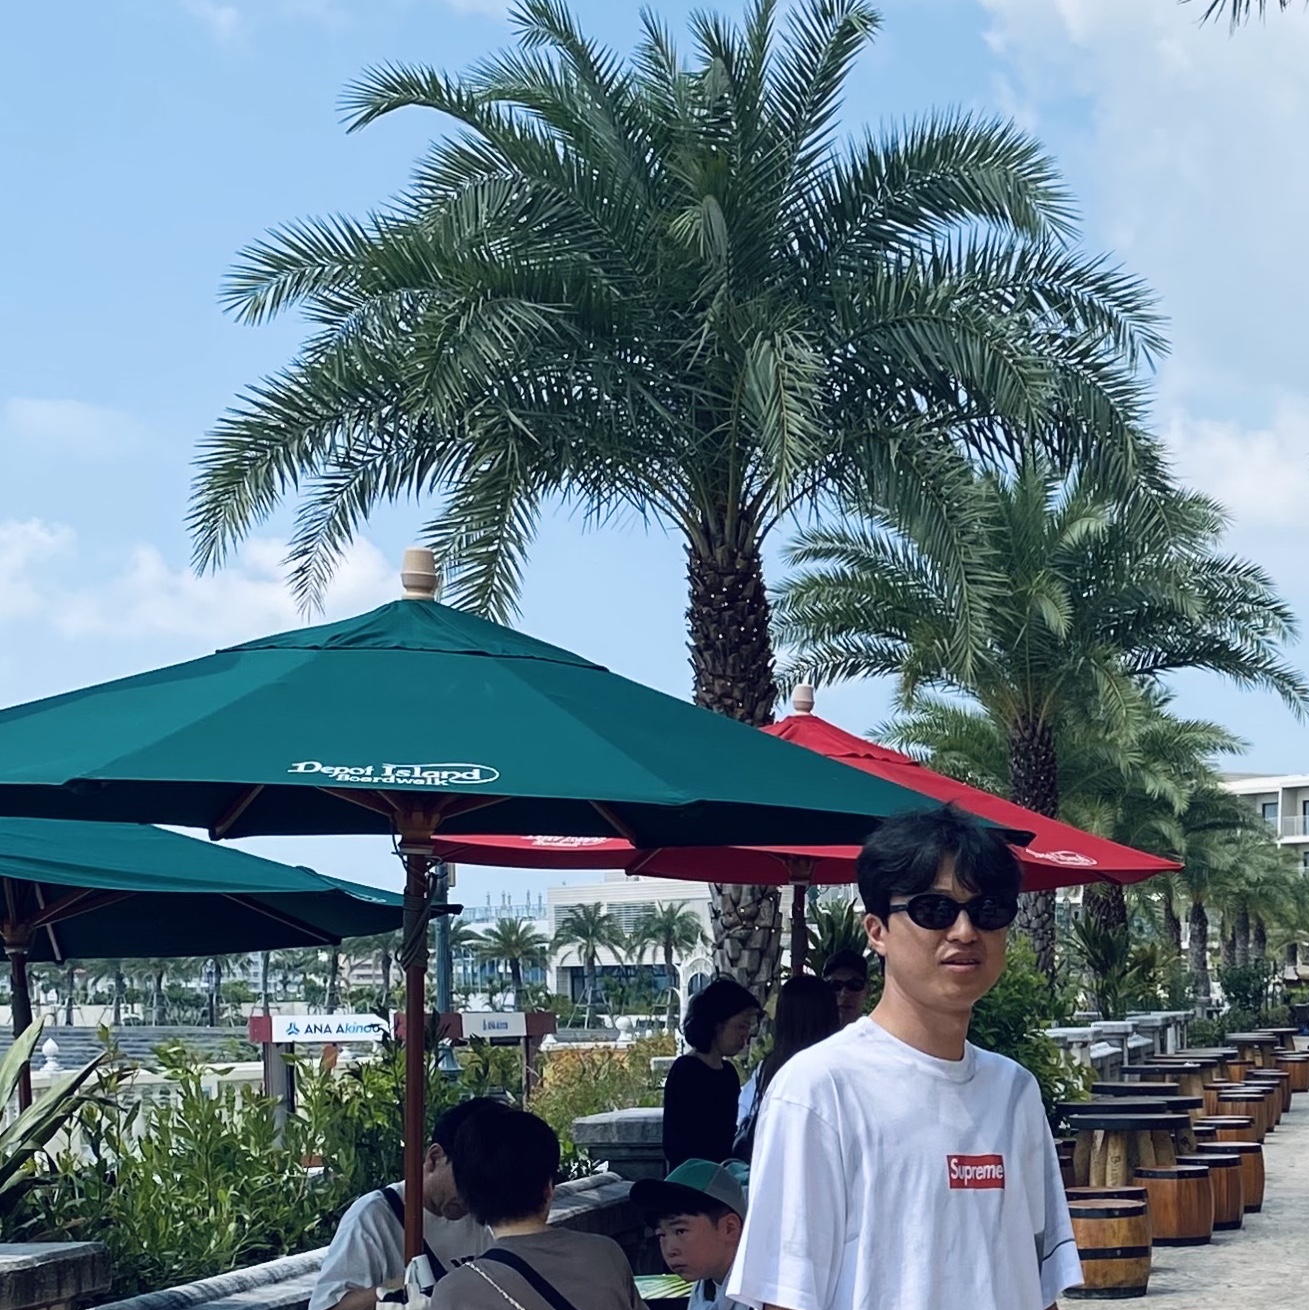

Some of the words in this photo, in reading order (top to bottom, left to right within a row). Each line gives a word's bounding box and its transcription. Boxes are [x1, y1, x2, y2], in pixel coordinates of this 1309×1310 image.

[287, 761, 374, 778] Depot
[383, 763, 483, 781] Island
[336, 773, 450, 787] Boardwalk
[304, 1023, 332, 1034] ANA
[950, 1158, 1004, 1186] Supreme
